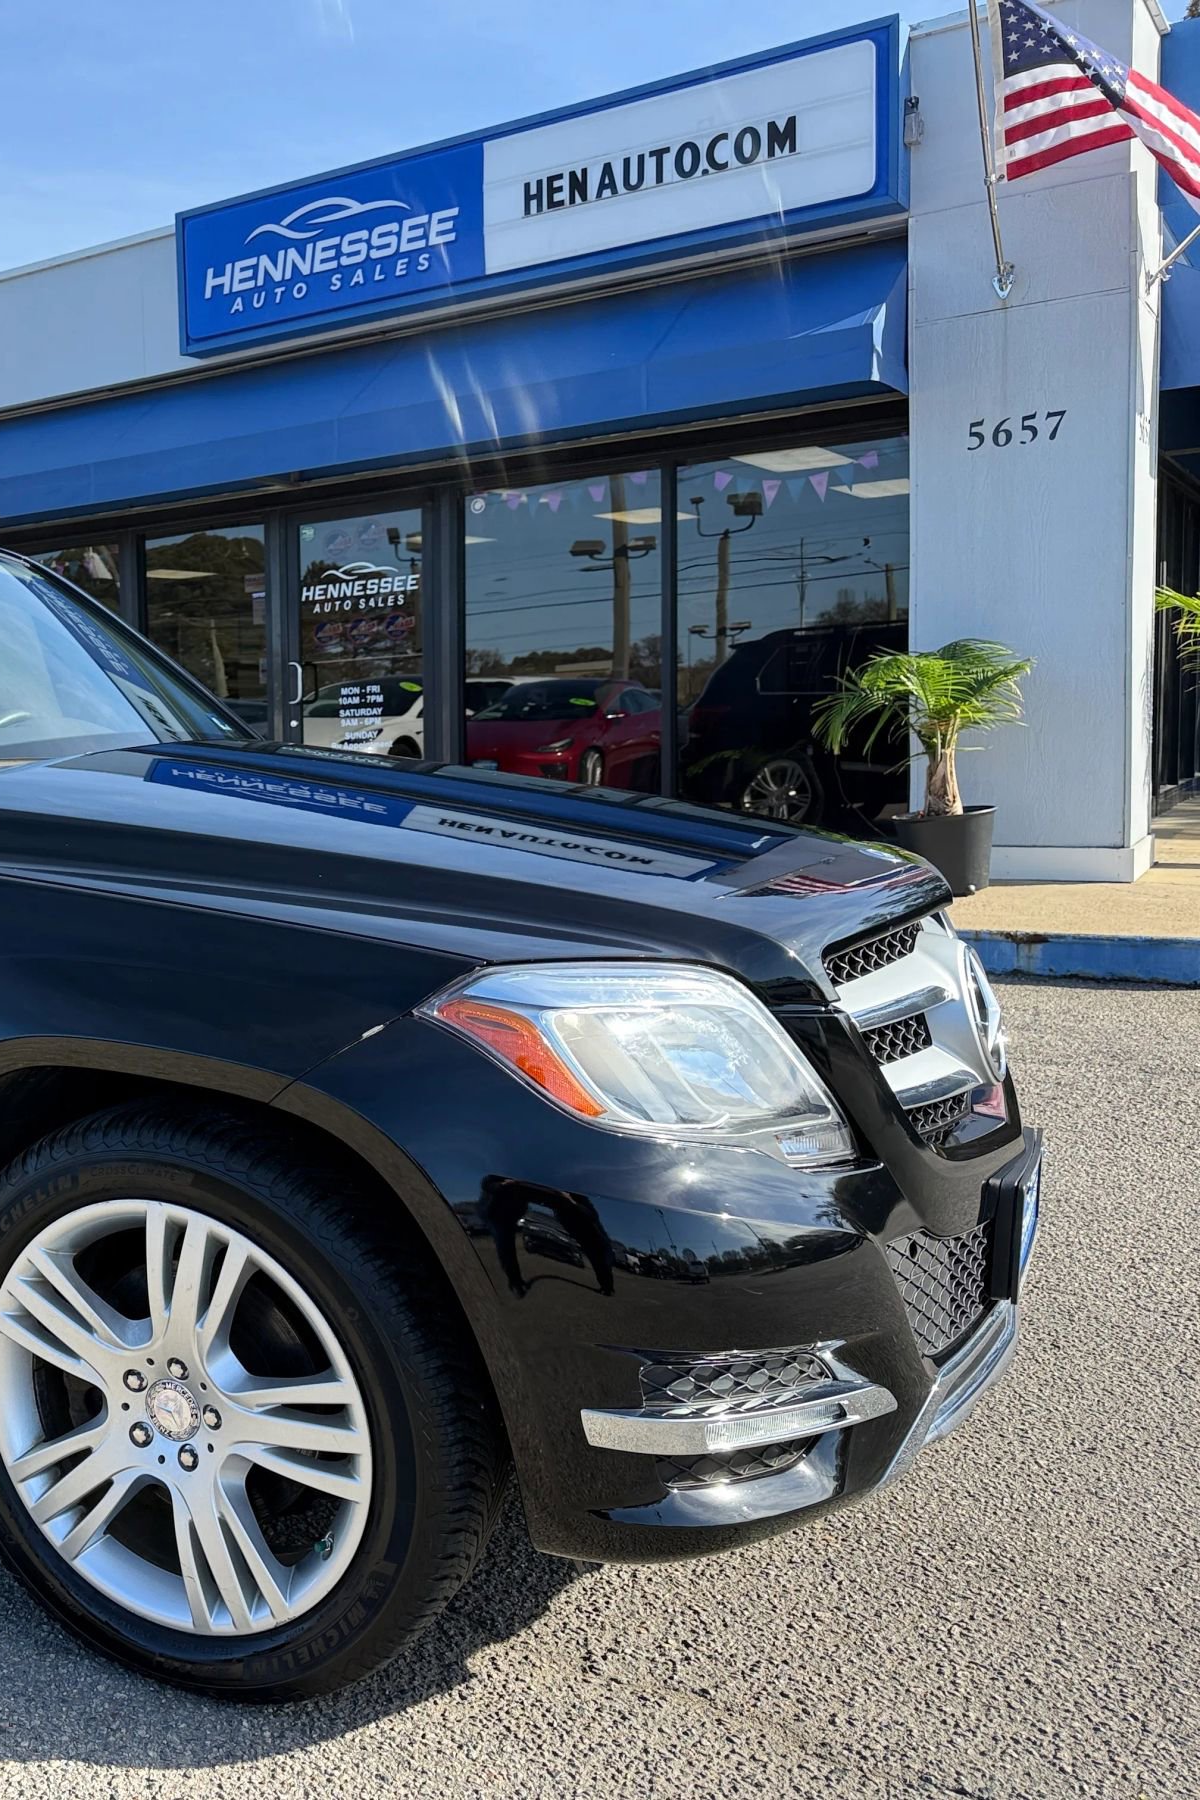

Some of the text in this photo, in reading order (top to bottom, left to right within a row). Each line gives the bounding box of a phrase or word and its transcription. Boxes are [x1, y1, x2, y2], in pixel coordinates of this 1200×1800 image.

[204, 207, 460, 300] HENNESSEE
[231, 253, 431, 315] AUTO SALES
[967, 410, 1067, 452] 5657
[301, 574, 420, 602] HENNESSEE
[312, 594, 405, 615] AUTO SALES
[338, 696, 360, 705] 10AM
[366, 694, 383, 703] 7PM
[340, 686, 360, 695] MON
[366, 685, 381, 693] FRI
[339, 707, 383, 717] SATURDAY
[344, 730, 378, 740] SUNDAY
[165, 1382, 199, 1415] MERCEDES
[253, 1601, 367, 1673] MICHELIN
